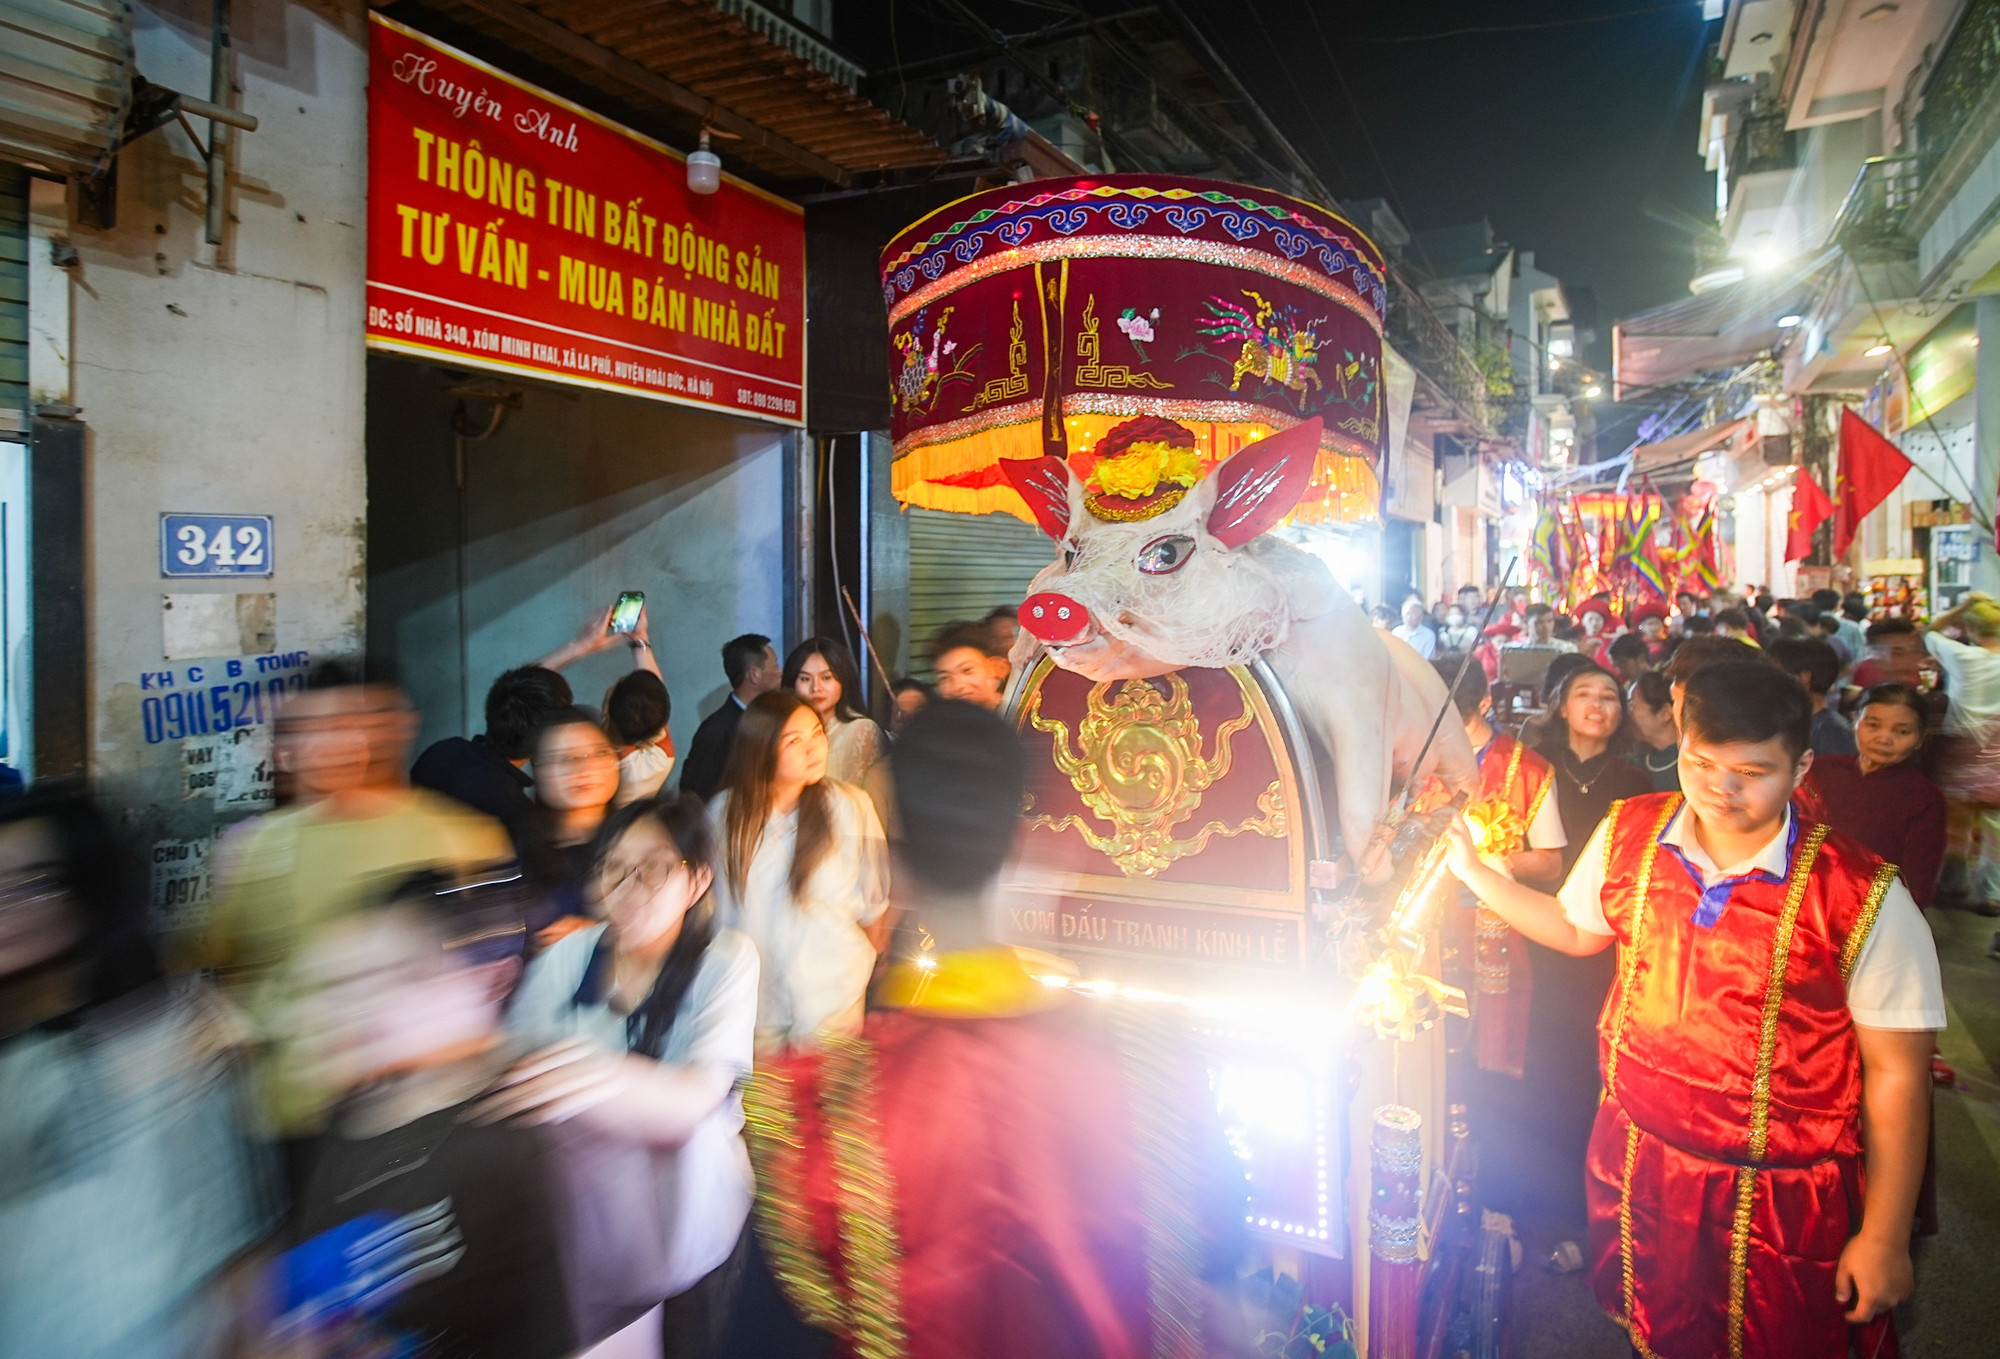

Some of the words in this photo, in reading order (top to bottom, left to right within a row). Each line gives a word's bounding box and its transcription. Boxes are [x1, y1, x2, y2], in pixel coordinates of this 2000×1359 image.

[514, 108, 578, 152] Anh
[413, 127, 536, 218] THÔNG
[545, 178, 596, 238] TIN
[604, 197, 657, 258] BẤT
[663, 222, 730, 284] ĐỘNG
[735, 244, 780, 301] SẢN
[396, 203, 450, 266] TƯ
[456, 218, 528, 290] VẤN
[537, 268, 549, 281] -
[559, 255, 625, 316] MUA
[632, 276, 686, 333] BÁN
[692, 300, 741, 348] NHÀ
[746, 307, 787, 359] ĐẤT
[368, 305, 393, 330] ĐC:
[394, 307, 414, 334] SỐ
[415, 316, 442, 340] NHÀ
[444, 323, 471, 349] 340,
[473, 328, 500, 353] XÓM
[501, 335, 531, 359] MINH
[532, 342, 561, 368] KHAI,
[562, 347, 577, 368] XÃ
[578, 353, 589, 370] LA
[591, 355, 613, 377] PHÚ,
[614, 361, 644, 385] HUYỆN
[645, 367, 666, 387] HOÀI
[687, 375, 699, 395] HÀ
[699, 378, 714, 400] NỘI
[177, 525, 264, 566] 342
[141, 671, 174, 690] KH
[226, 660, 242, 678] B
[1061, 904, 1107, 941] ĐẤU
[1113, 920, 1188, 950] TRANH
[1195, 923, 1252, 958] KÍNH
